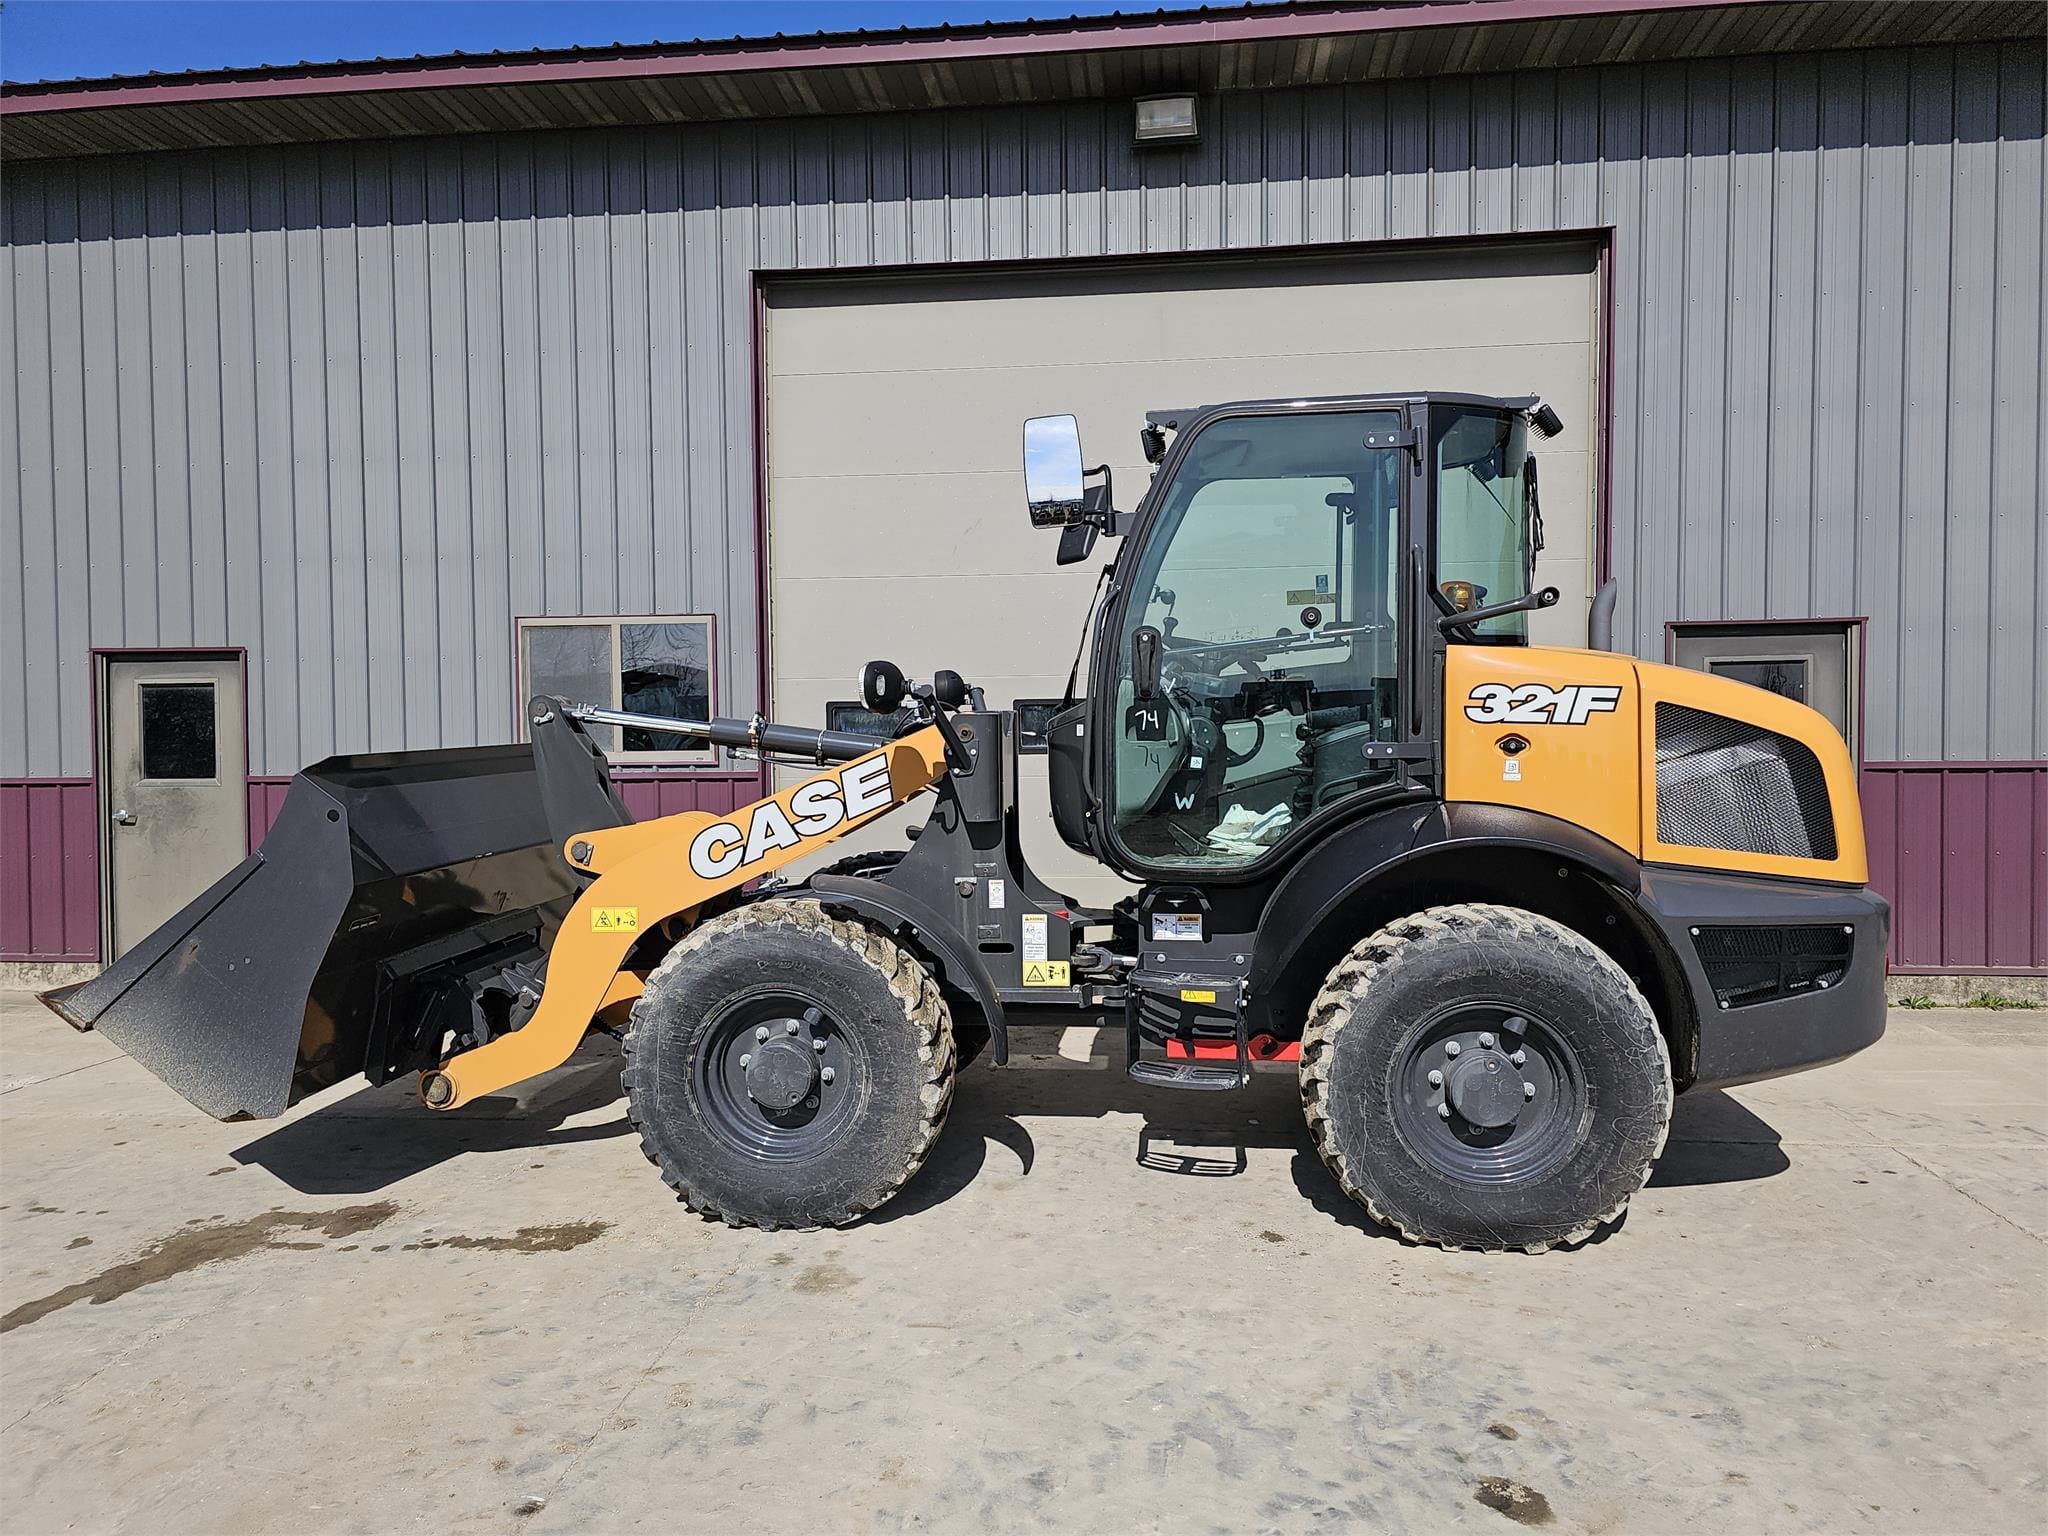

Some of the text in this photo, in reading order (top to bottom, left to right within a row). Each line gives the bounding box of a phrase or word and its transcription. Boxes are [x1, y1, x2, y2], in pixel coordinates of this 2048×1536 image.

[1135, 709, 1159, 730] 74
[1464, 683, 1623, 725] 321F
[689, 752, 893, 879] CASE
